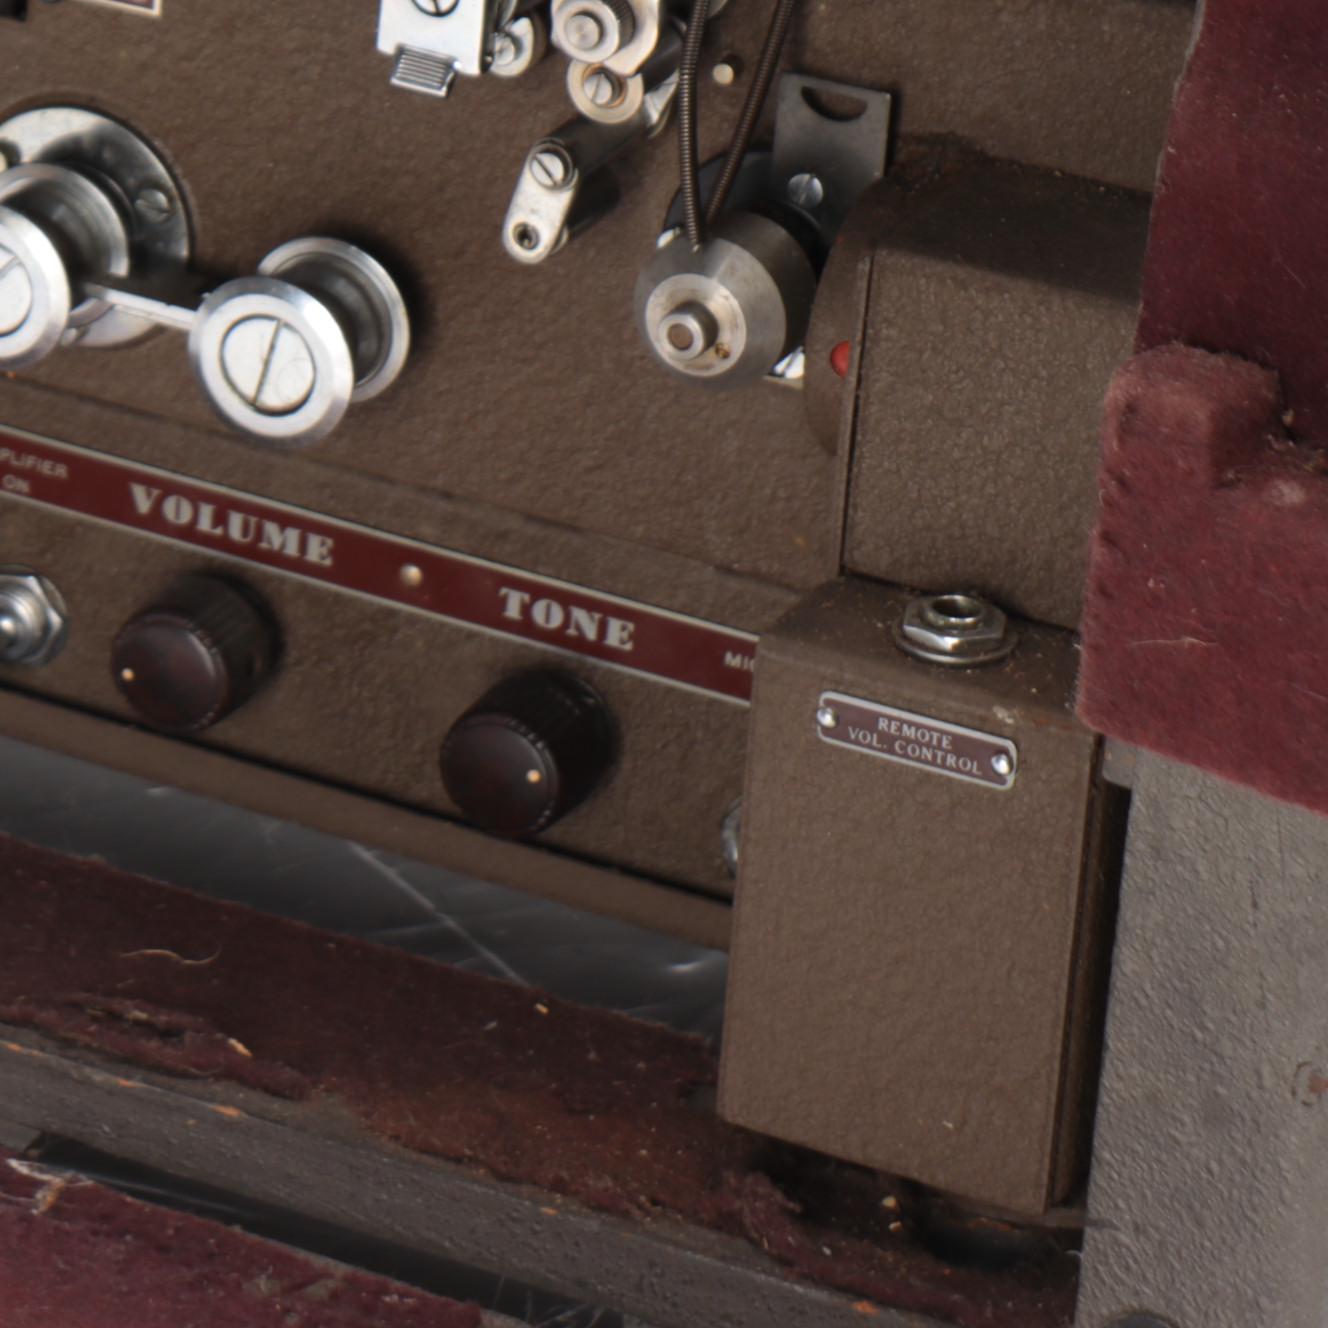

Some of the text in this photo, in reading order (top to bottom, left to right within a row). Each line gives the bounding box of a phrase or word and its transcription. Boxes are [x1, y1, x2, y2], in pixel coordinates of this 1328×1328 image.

[2, 474, 30, 493] ON
[129, 482, 334, 566] VOLUME
[498, 586, 635, 651] TONE
[848, 726, 983, 775] VOL. CONTROL
[877, 717, 953, 750] REMOTE
